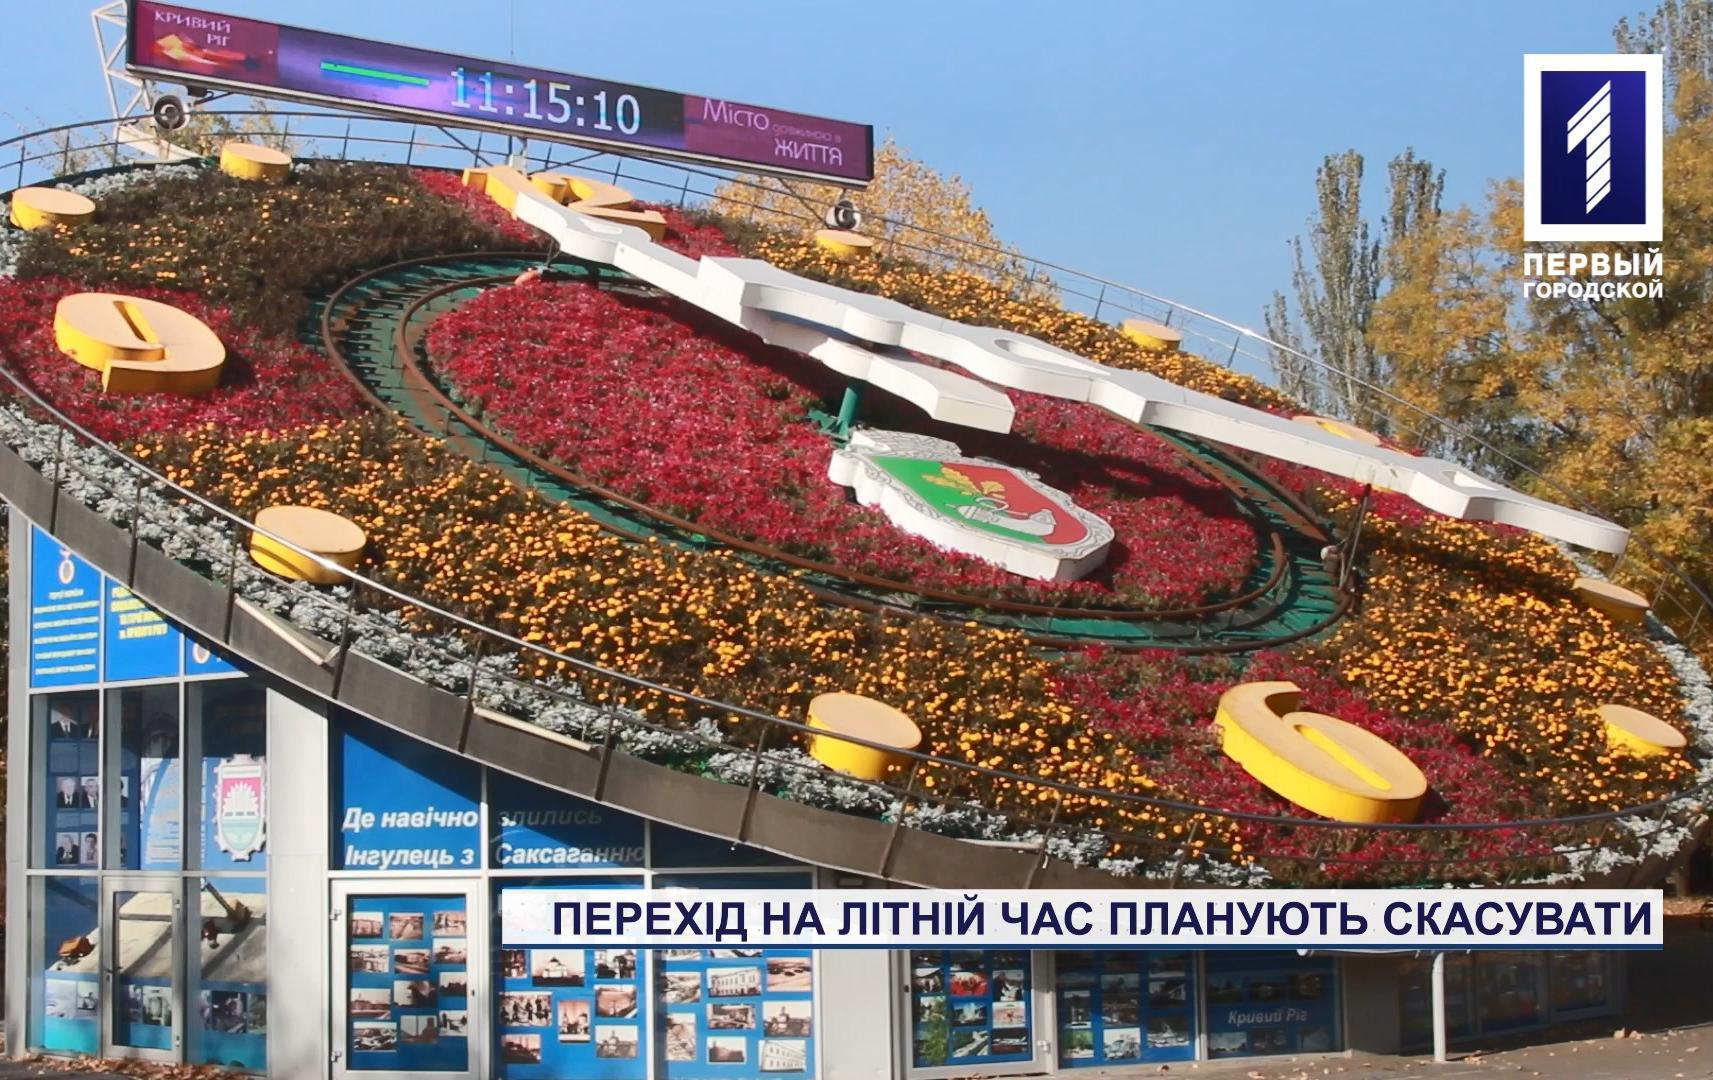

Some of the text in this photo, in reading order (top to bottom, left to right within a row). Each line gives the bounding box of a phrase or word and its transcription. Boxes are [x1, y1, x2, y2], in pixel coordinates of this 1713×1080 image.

[154, 11, 231, 34] КРИВИЙ
[450, 66, 641, 136] 11:15:10
[341, 807, 376, 833] Де
[381, 806, 479, 828] навічно
[344, 845, 455, 870] Інгулець
